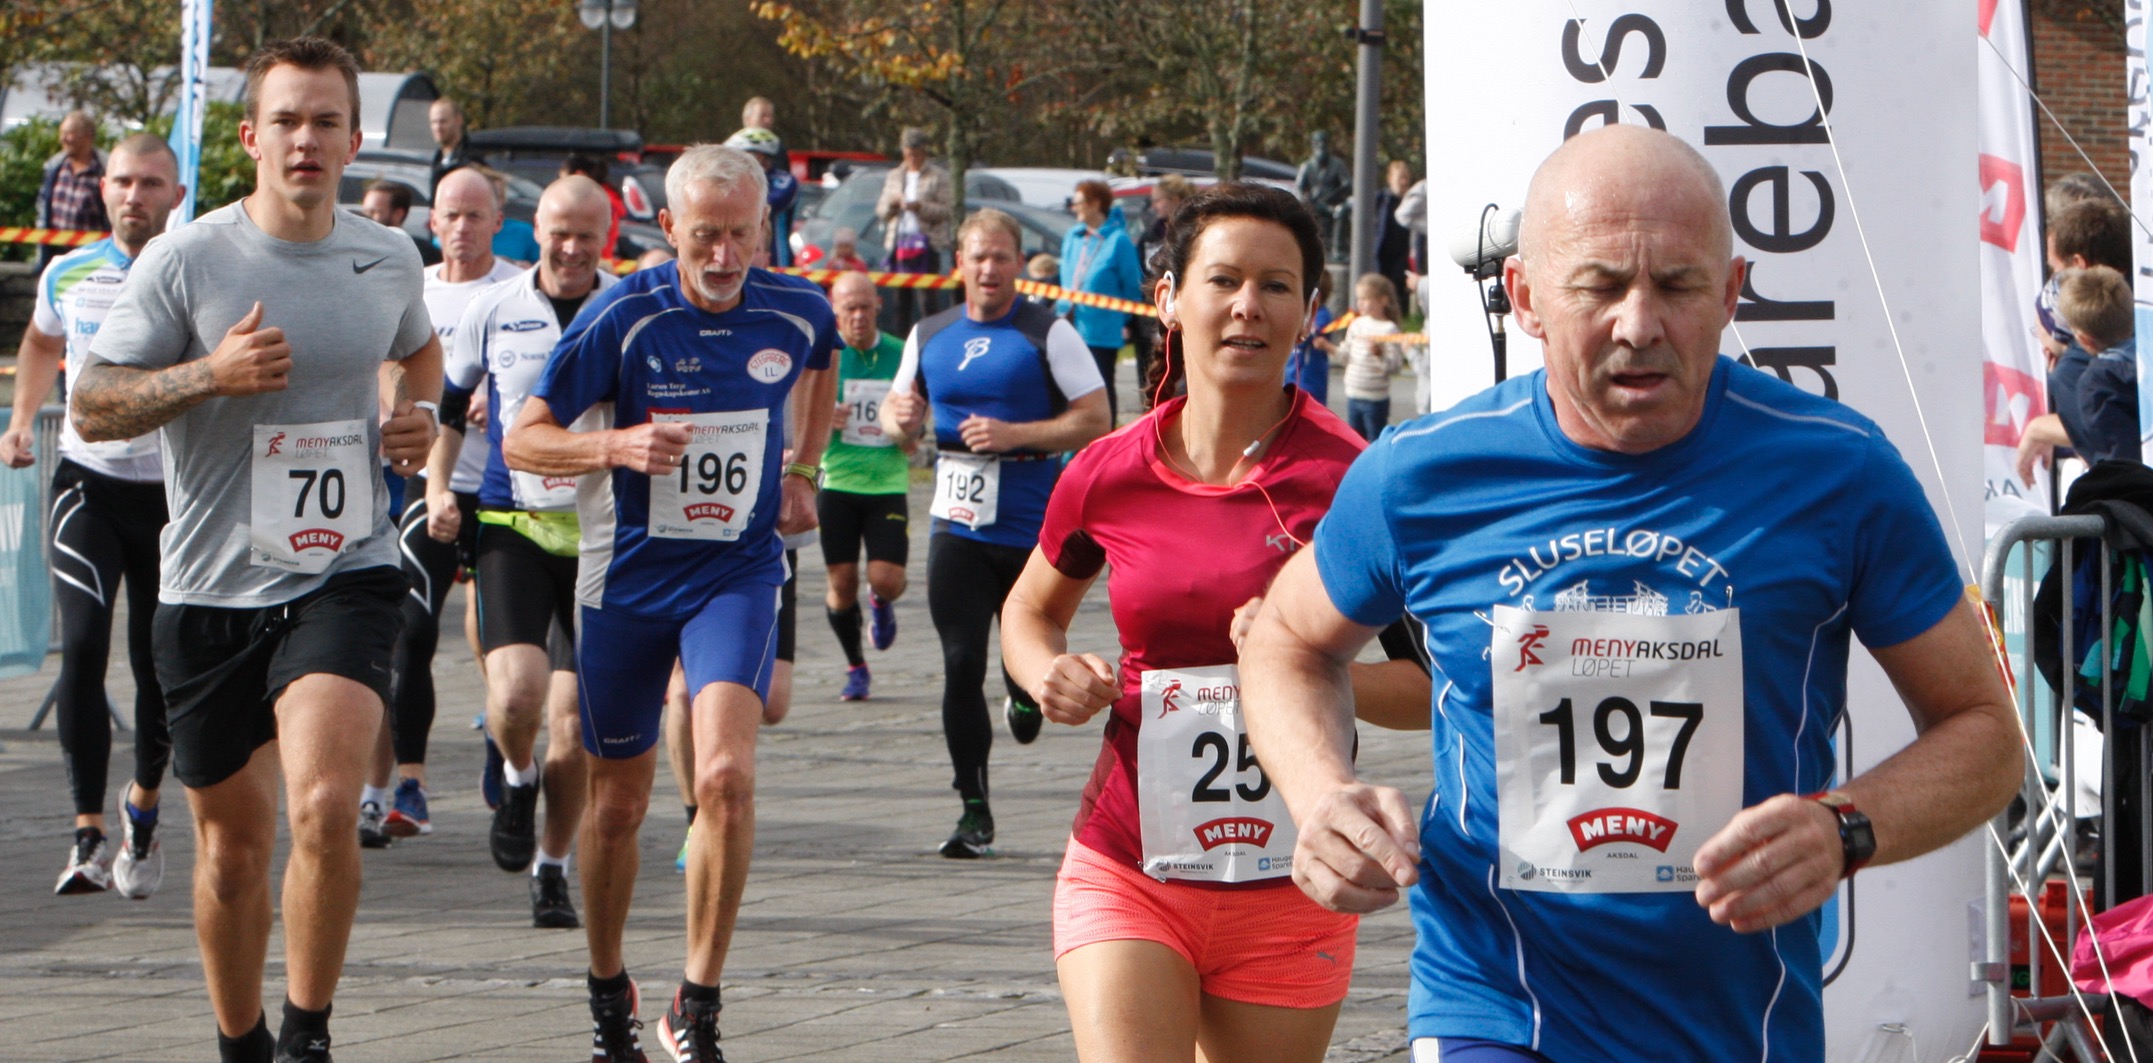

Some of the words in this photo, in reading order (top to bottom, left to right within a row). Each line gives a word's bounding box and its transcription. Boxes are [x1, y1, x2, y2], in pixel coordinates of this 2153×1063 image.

[677, 452, 747, 495] 196
[289, 468, 345, 519] 70
[946, 471, 985, 504] 192
[688, 505, 730, 518] MENY
[294, 532, 339, 548] MENY
[1498, 528, 1729, 597] SLUSELØPET
[1571, 638, 1724, 661] MENYAKSDAL
[1571, 658, 1637, 678] LØPET
[1539, 696, 1704, 790] 197
[1192, 731, 1272, 802] 25
[1203, 823, 1266, 843] MENY
[1579, 815, 1667, 841] MENY
[1173, 863, 1214, 871] STEINSVIK
[1539, 868, 1592, 878] STEINSVIK
